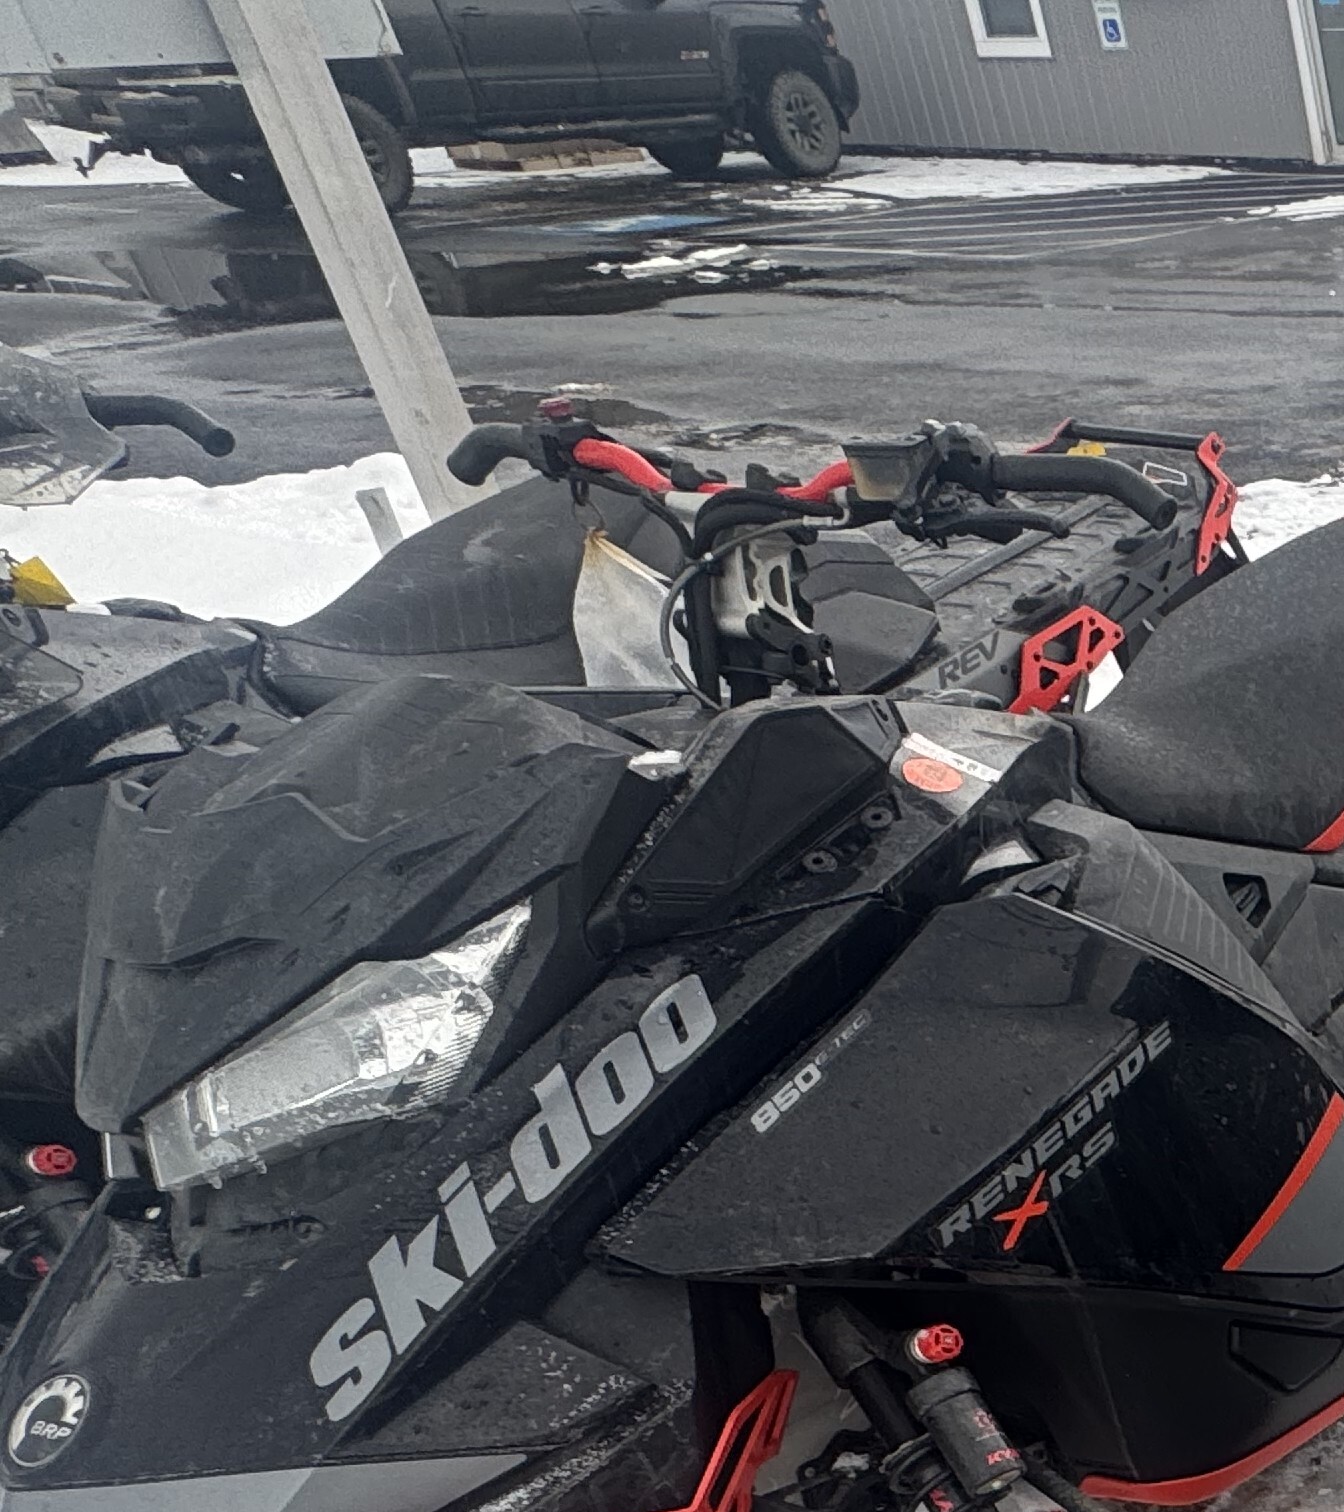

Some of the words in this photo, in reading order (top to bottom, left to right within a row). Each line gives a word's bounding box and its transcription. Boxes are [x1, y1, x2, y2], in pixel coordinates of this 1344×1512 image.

[938, 629, 1000, 690] REV
[750, 1062, 822, 1133] 850
[936, 1020, 1172, 1248] RENEGADE
[309, 974, 717, 1422] ski-doo
[30, 1420, 72, 1440] BRP
